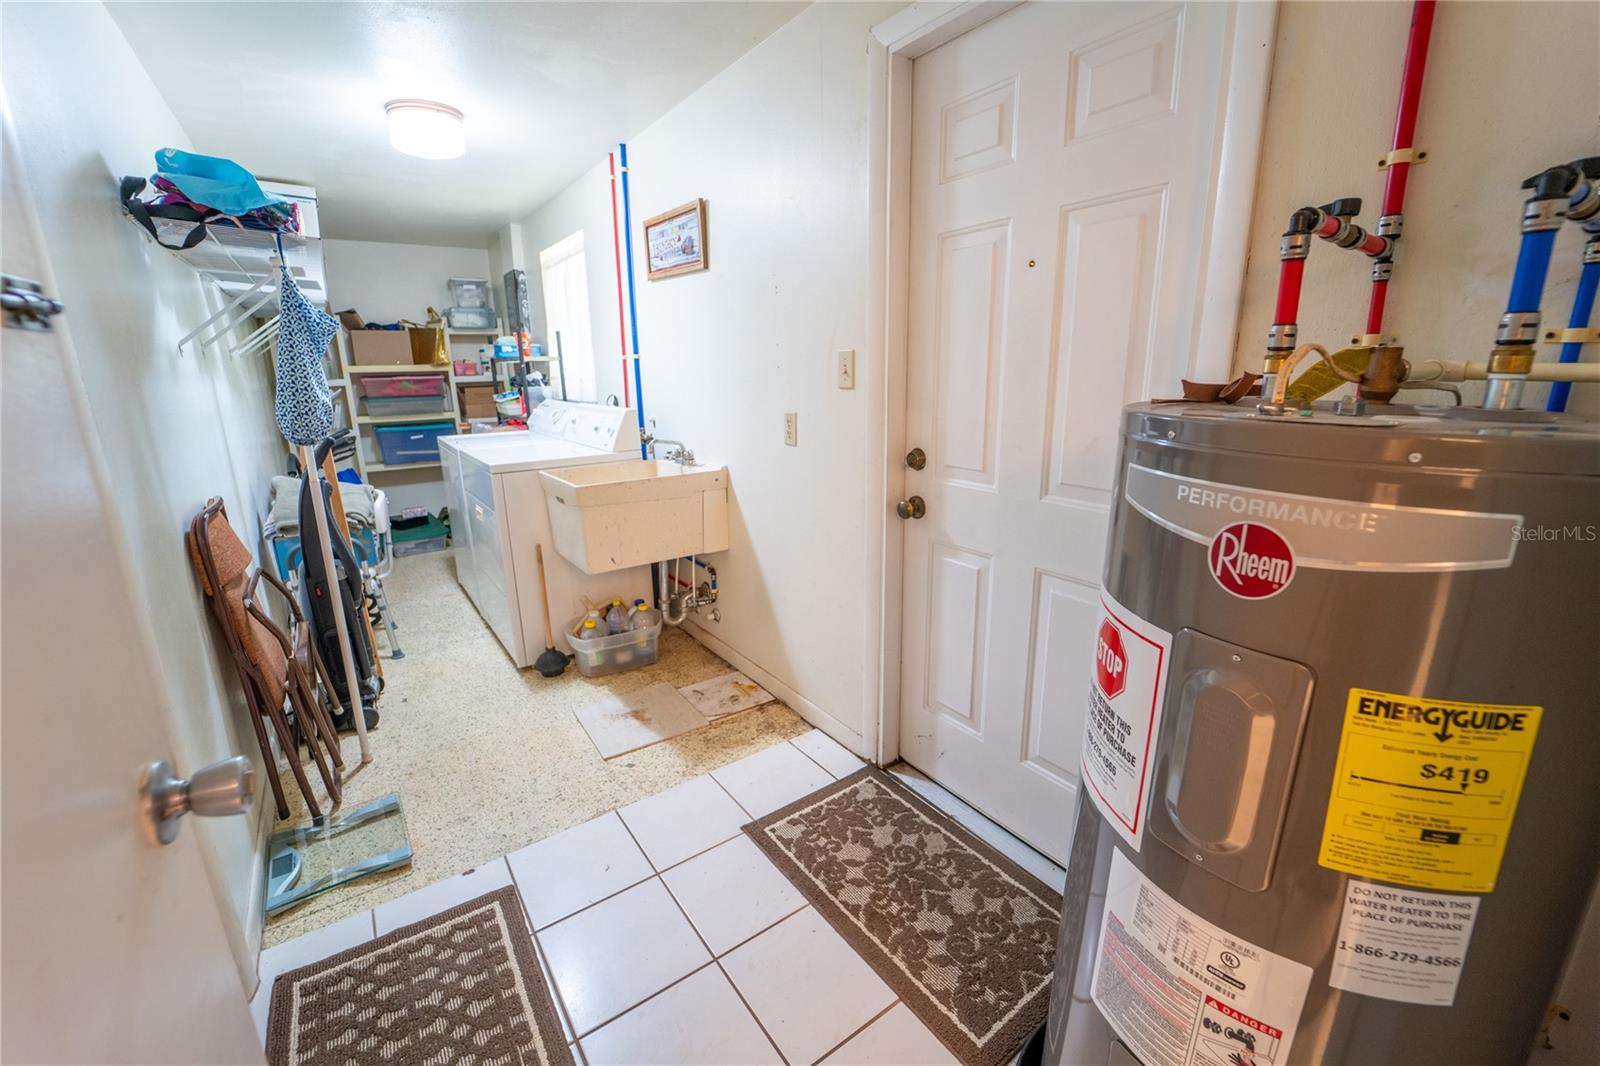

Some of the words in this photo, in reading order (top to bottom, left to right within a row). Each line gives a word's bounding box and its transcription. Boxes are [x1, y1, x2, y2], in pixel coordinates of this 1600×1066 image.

[1177, 485, 1379, 532] PERFORMANCE
[1216, 524, 1289, 585] Rheem
[1098, 636, 1123, 679] STOP
[1097, 706, 1116, 735] HEATER
[1116, 728, 1126, 744] TO
[1116, 714, 1132, 736] THIS
[1358, 696, 1528, 733] ENERGYGUIDE
[1102, 727, 1137, 768] PURCHASE
[1420, 763, 1490, 784] $419
[1348, 896, 1388, 911] WATER
[1389, 905, 1432, 918] HEATER
[1435, 911, 1450, 919] TO
[1452, 913, 1472, 921] THE
[1353, 886, 1371, 896] DO
[1373, 891, 1398, 901] NOT
[1400, 895, 1445, 908] RETURN
[1449, 901, 1473, 911] THIS
[1352, 909, 1385, 922] PLACE
[1388, 915, 1403, 924] OF
[1406, 918, 1463, 931] PURCHASE
[1339, 940, 1462, 968] 1-866-279-4566
[1223, 1003, 1278, 1036] DANGER
